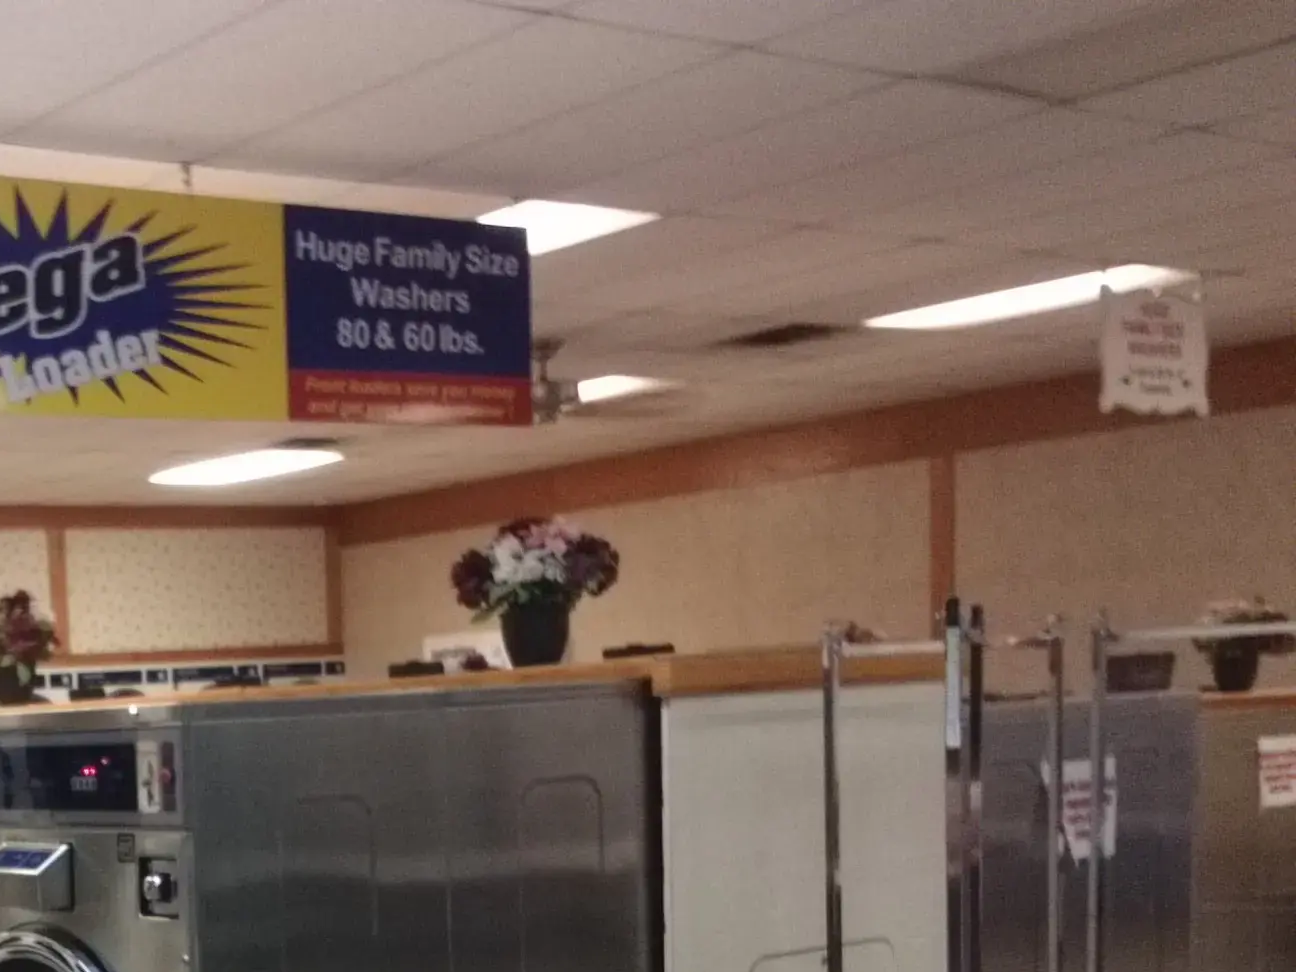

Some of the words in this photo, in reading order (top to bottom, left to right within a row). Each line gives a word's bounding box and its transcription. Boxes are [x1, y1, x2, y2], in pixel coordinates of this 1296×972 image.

[295, 228, 370, 272] Huge
[374, 236, 461, 280] Family
[465, 243, 520, 278] Size
[350, 276, 472, 314] Washers
[336, 317, 370, 349] 80
[373, 318, 396, 350] &
[403, 321, 435, 353] 60
[439, 323, 486, 355] lbs.
